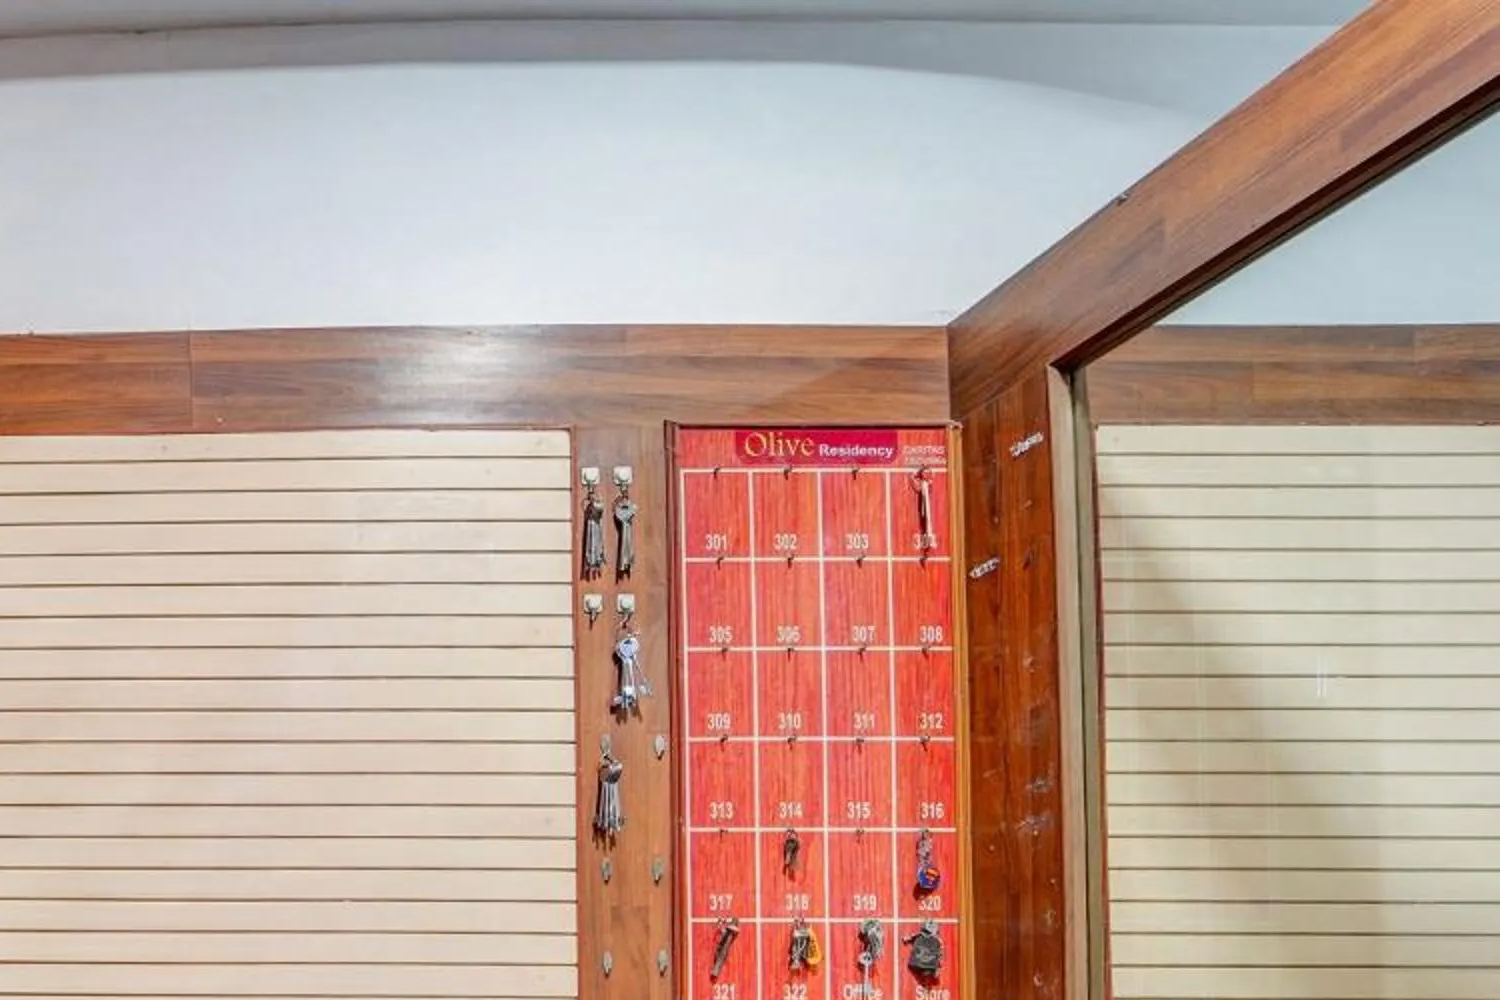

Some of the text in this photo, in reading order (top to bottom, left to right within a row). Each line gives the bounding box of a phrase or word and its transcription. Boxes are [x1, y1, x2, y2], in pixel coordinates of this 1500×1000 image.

[745, 431, 894, 458] Olive Residency
[705, 533, 728, 550] 301
[774, 533, 797, 550] 302
[845, 533, 869, 550] 303
[708, 626, 733, 643] 305
[776, 626, 800, 643] 306
[851, 626, 875, 643] 307
[919, 626, 943, 643] 308
[707, 713, 732, 730] 309
[778, 713, 801, 730] 310
[853, 713, 875, 730] 311
[919, 713, 943, 730] 312
[709, 802, 734, 819] 313
[779, 802, 802, 819] 314
[847, 802, 871, 819] 315
[921, 802, 945, 819] 316
[709, 894, 733, 911] 317
[785, 894, 809, 911] 318
[853, 894, 877, 911] 319
[918, 894, 942, 911] 320
[712, 984, 736, 1000] 321
[783, 984, 808, 1000] 322
